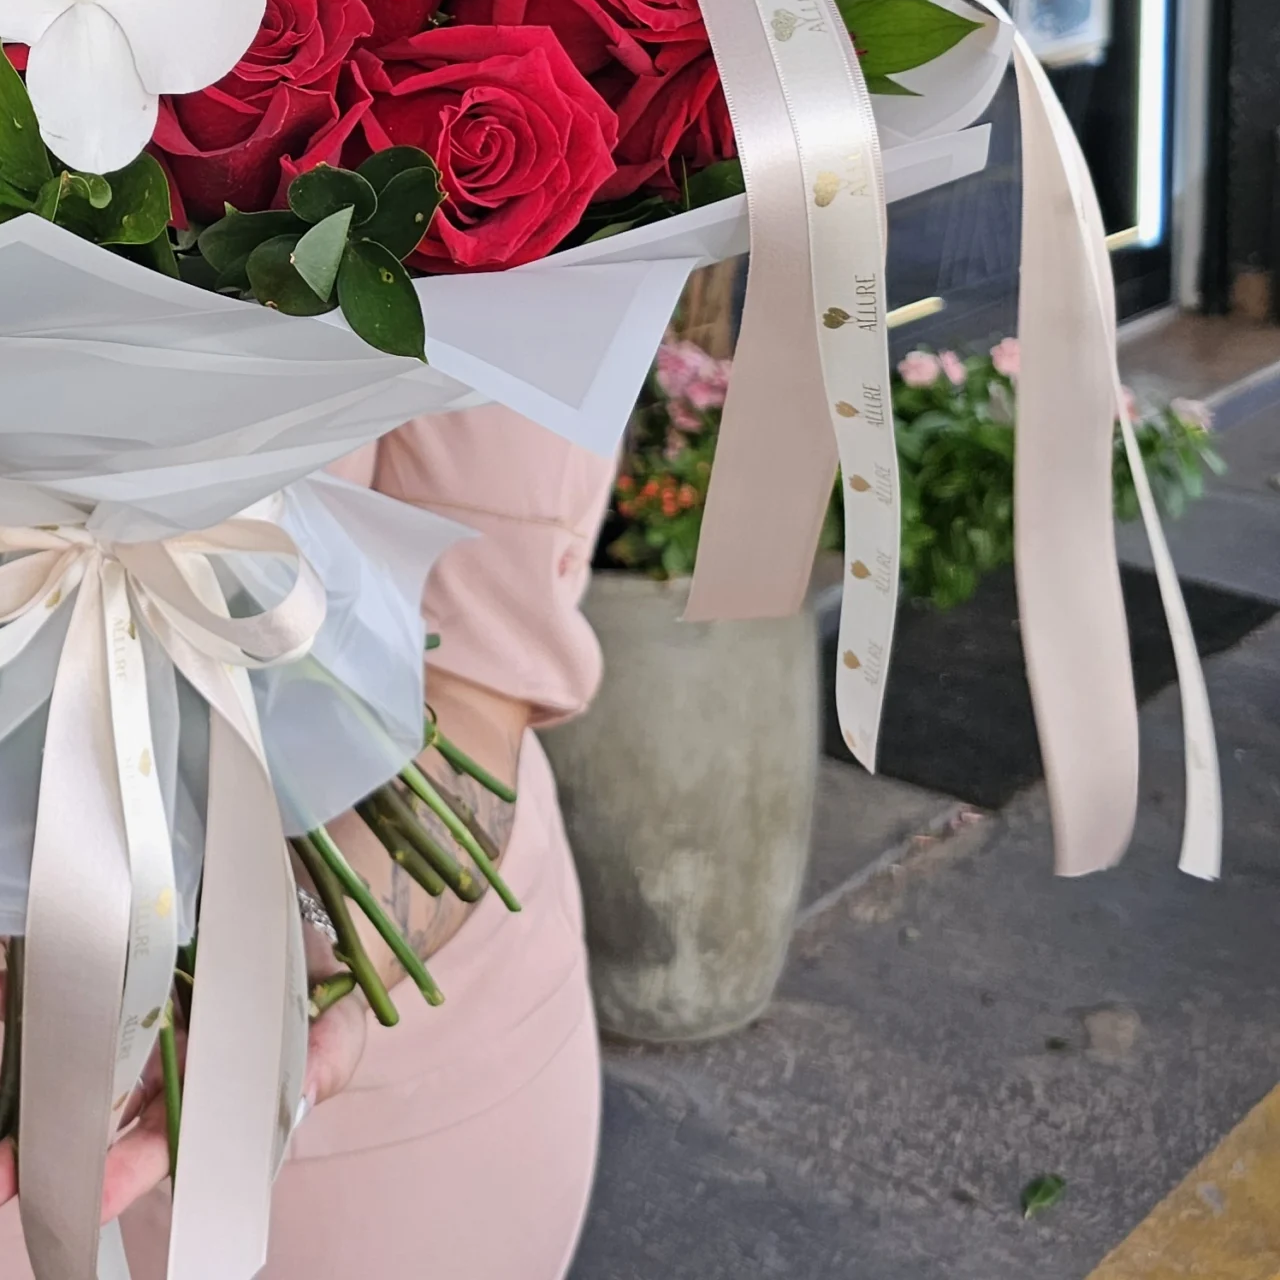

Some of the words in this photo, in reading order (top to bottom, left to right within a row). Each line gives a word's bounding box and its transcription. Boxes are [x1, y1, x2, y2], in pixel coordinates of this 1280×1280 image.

[854, 272, 877, 332] ALLURE
[862, 382, 884, 430] ALLURE
[113, 617, 127, 682] ALLURE
